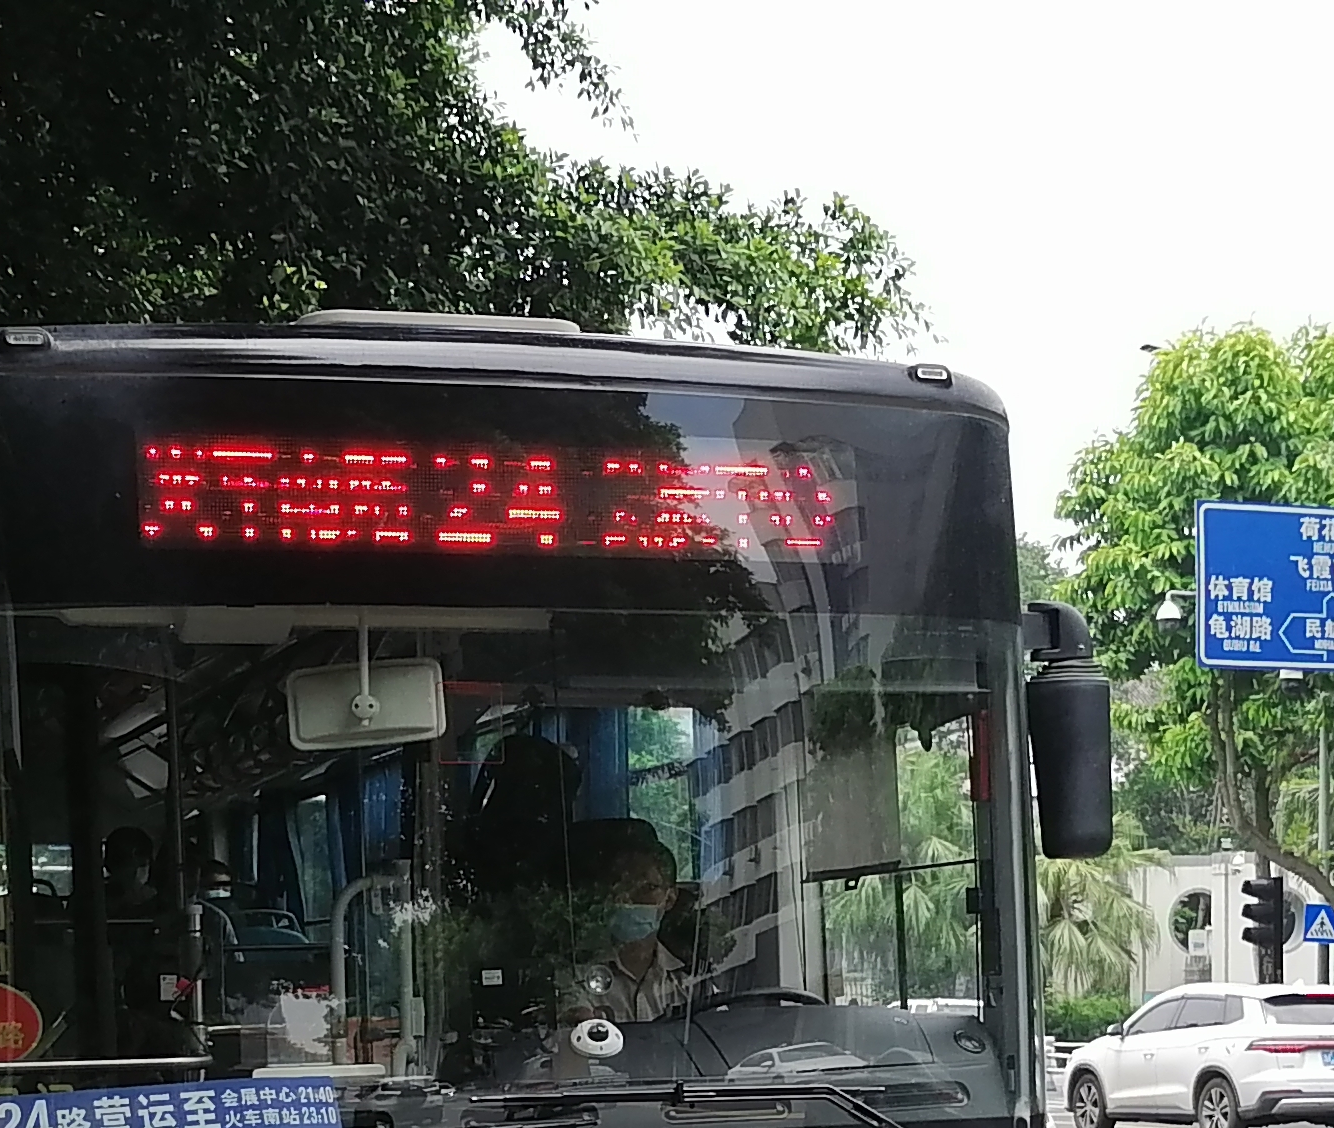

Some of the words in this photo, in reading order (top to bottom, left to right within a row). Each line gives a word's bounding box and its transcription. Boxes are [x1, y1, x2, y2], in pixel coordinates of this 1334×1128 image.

[1208, 575, 1273, 602] 体育馆
[1306, 579, 1332, 592] FEIXIA
[1208, 613, 1272, 640] 龟湖路
[220, 1086, 297, 1107] 会展中心
[298, 1086, 334, 1103] 21:40
[225, 1107, 300, 1128] 火车南站
[301, 1106, 337, 1125] 23:10
